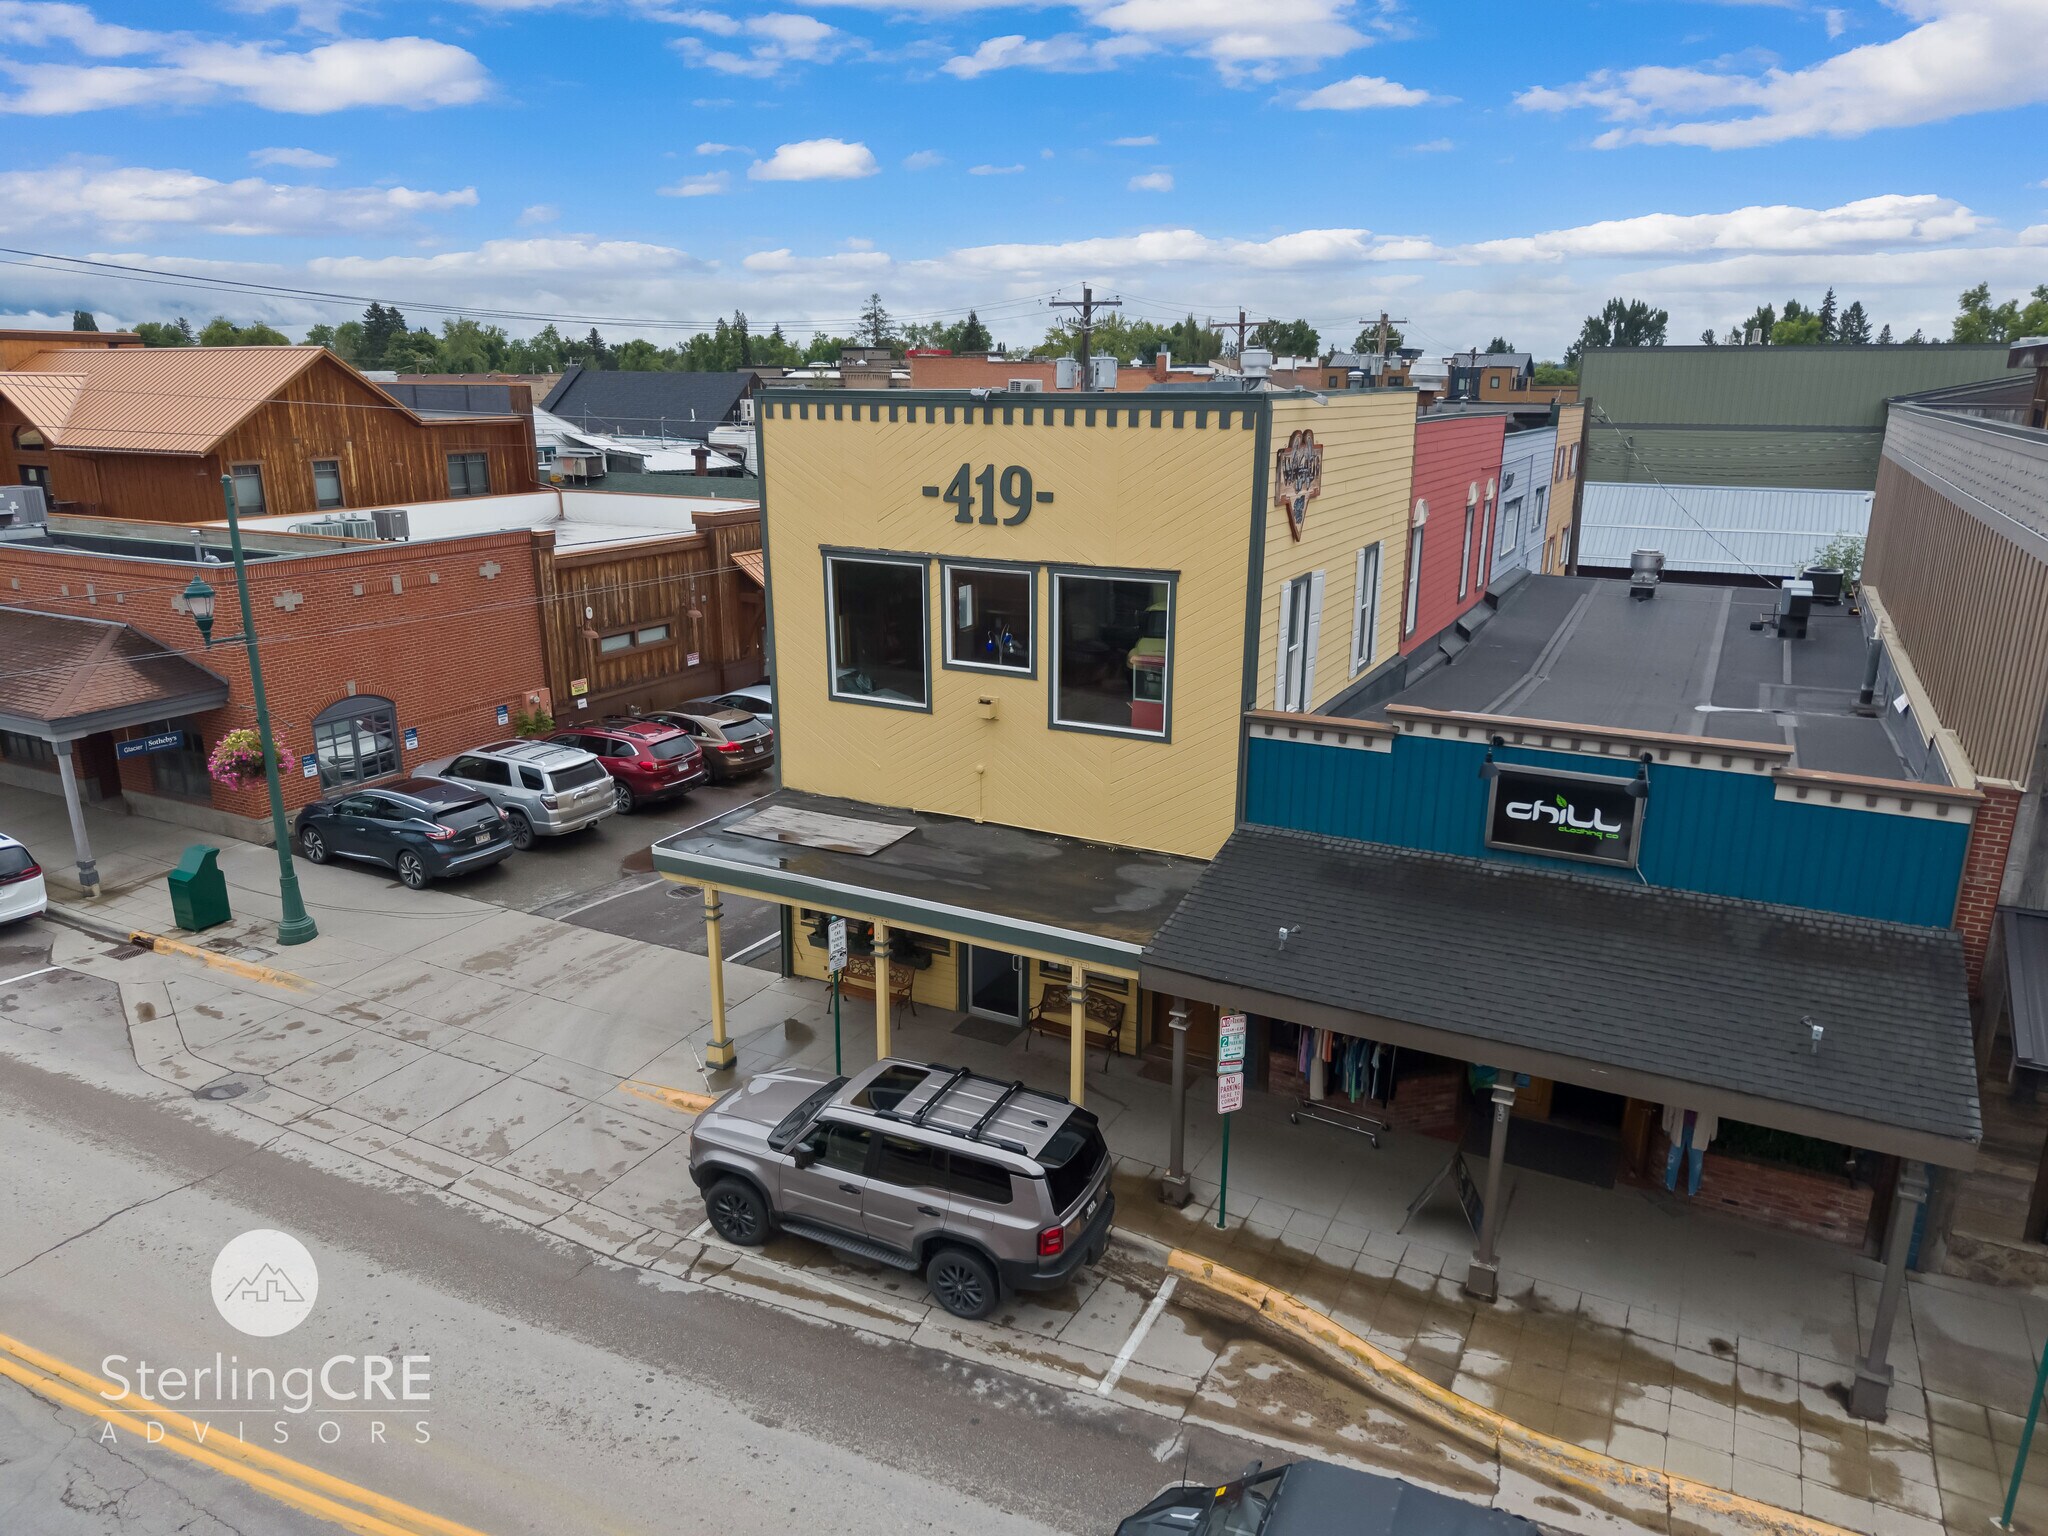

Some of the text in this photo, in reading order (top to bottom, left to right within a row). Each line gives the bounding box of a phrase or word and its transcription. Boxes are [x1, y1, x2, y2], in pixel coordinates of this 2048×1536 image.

[123, 744, 144, 754] Glacier
[148, 735, 178, 747] Sotheby's
[1222, 1037, 1228, 1047] 2
[1226, 1076, 1236, 1084] NO
[1220, 1083, 1241, 1093] PARKING
[1221, 1096, 1240, 1104] CORNER
